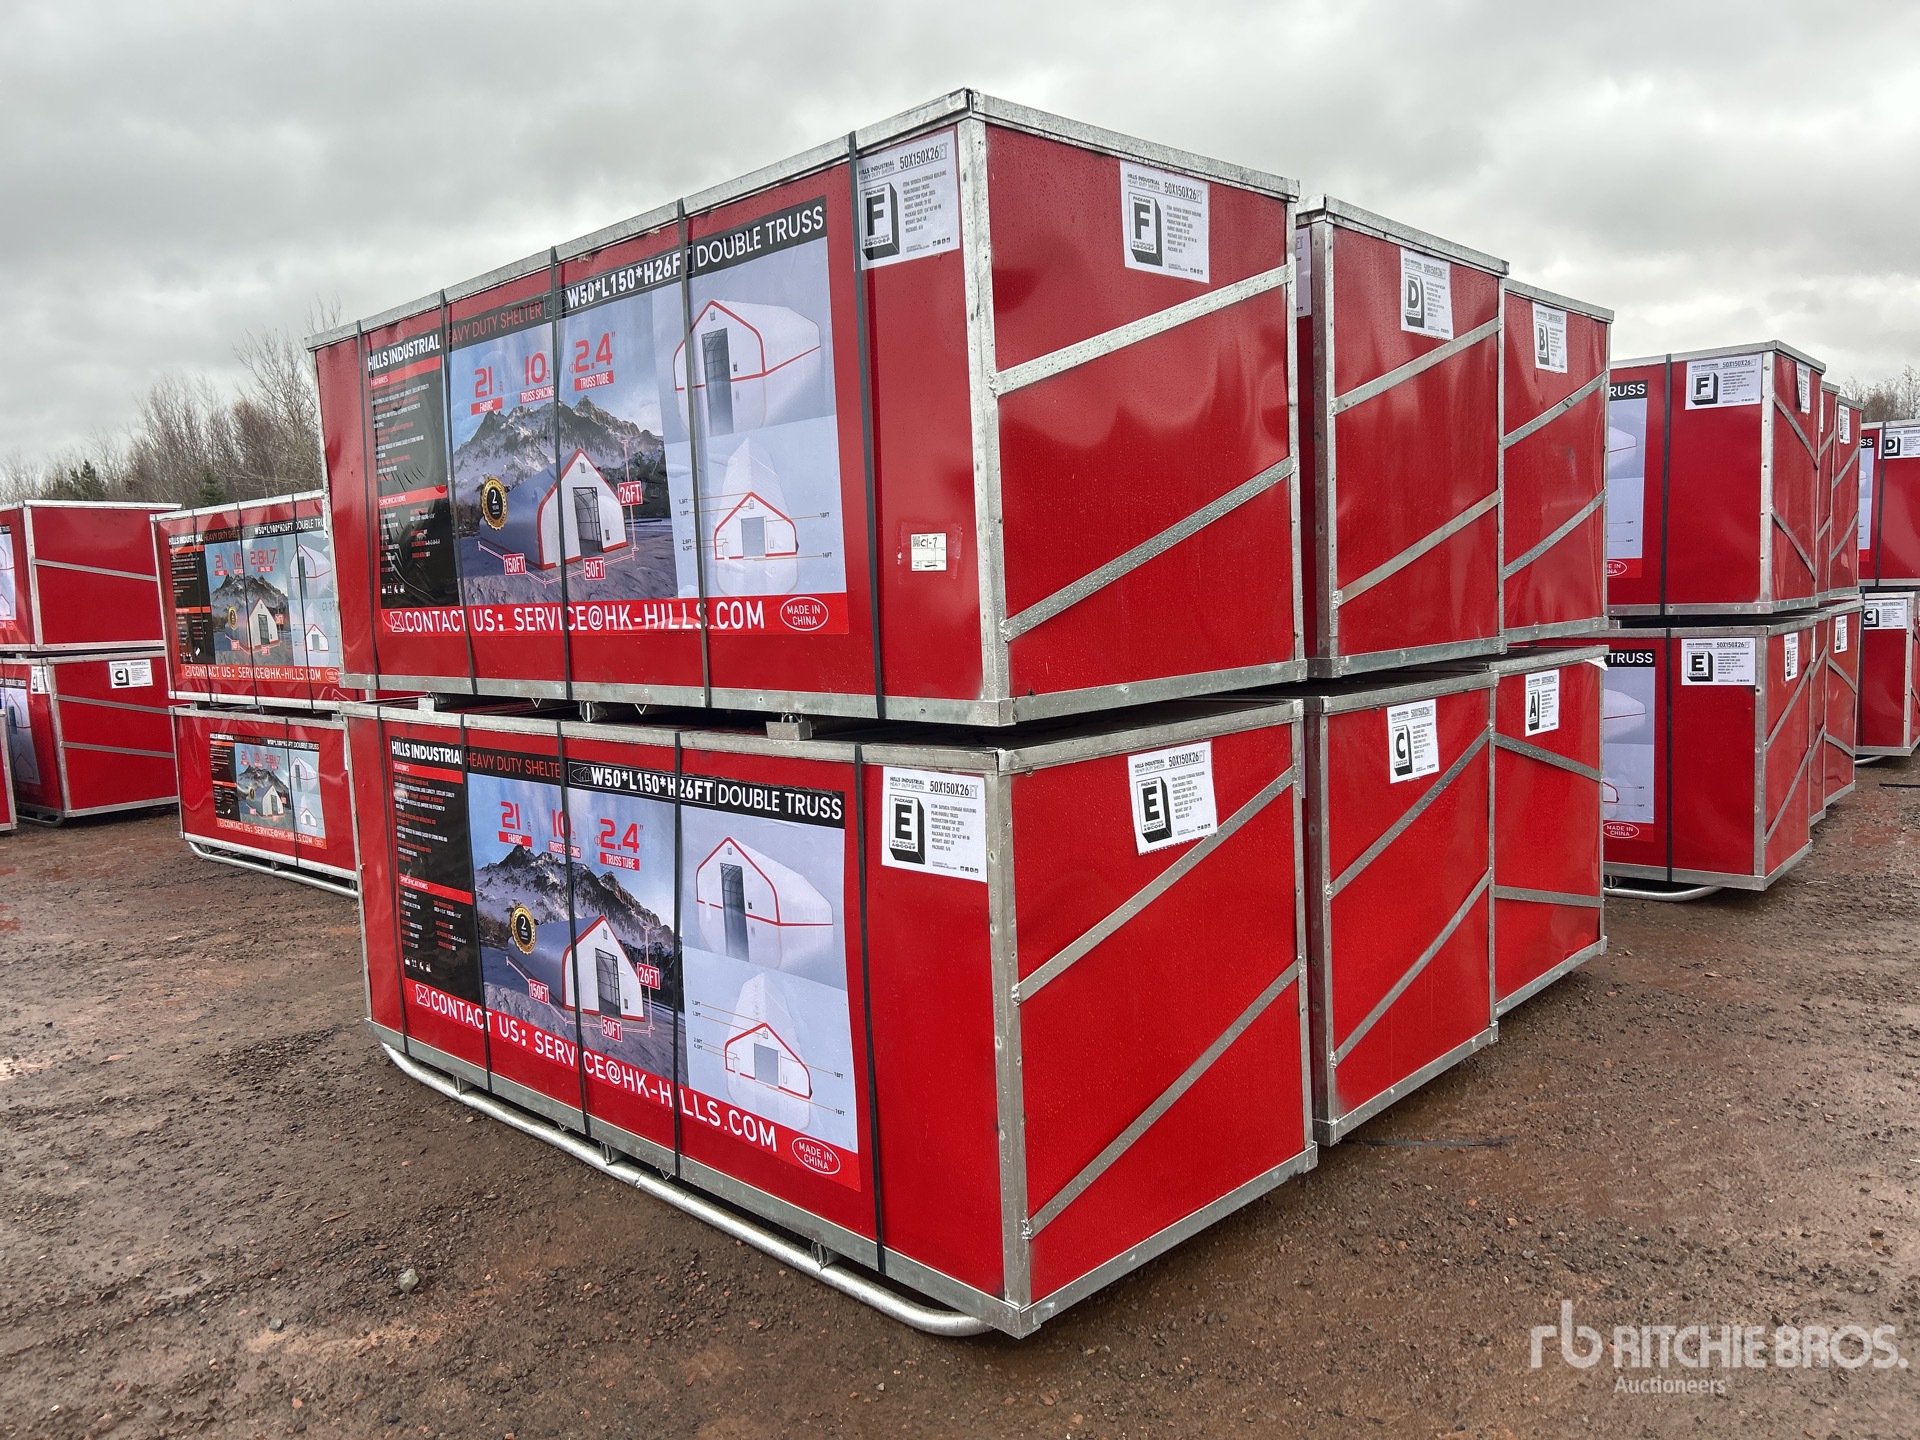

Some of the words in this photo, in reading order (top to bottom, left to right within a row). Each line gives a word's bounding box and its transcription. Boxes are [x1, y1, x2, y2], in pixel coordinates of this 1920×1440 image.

[870, 160, 894, 172] INDUSTRIAL
[866, 194, 884, 236] F
[1134, 202, 1150, 240] F
[697, 226, 762, 268] DOUBLE
[766, 206, 823, 244] TRUSS
[1408, 280, 1419, 308] D
[472, 315, 498, 338] DUTY
[500, 302, 542, 329] SHELTER
[1539, 328, 1545, 350] B
[368, 351, 388, 372] HILLS
[388, 334, 440, 364] INDUSTRIAL
[525, 352, 546, 386] 10
[474, 366, 493, 398] 21
[580, 376, 595, 389] TRUSS
[595, 374, 609, 386] TUBE
[1609, 384, 1645, 397] RUSS
[1696, 377, 1709, 396] F
[521, 391, 535, 403] TRUSS
[1886, 440, 1895, 450] D
[491, 490, 498, 504] 2
[619, 483, 641, 503] 26FT
[505, 556, 525, 574] 150FT
[585, 560, 604, 578] 50FT
[404, 609, 467, 632] CONTACT
[472, 608, 504, 632] US:
[514, 600, 764, 632] SERVICE@HK-HILLS.COM
[787, 605, 810, 614] MADE
[812, 604, 820, 614] IN
[1864, 610, 1873, 621] C
[792, 616, 817, 626] CHINA
[1610, 652, 1653, 664] TRUSS
[1692, 655, 1704, 671] E
[115, 671, 124, 680] C
[222, 667, 235, 678] US:
[1530, 695, 1536, 718] A
[391, 740, 411, 758] HILLS
[1396, 732, 1406, 759] C
[497, 756, 522, 774] DUTY
[525, 760, 560, 778] SHELTE
[718, 784, 780, 812] DOUBLE
[785, 792, 842, 820] TRUSS
[1142, 786, 1160, 822] E
[501, 801, 520, 830] 21
[895, 803, 912, 840] E
[606, 854, 622, 866] TRUSS
[622, 857, 635, 869] TUBE
[520, 916, 526, 930] 2
[639, 967, 659, 987] 26FT
[530, 983, 548, 1002] 150FT
[431, 991, 492, 1032] CONTACT
[499, 1016, 526, 1046] US:
[602, 1021, 621, 1039] 50FT
[799, 1142, 822, 1158] MADE
[824, 1150, 832, 1162] IN
[804, 1154, 829, 1170] CHINA
